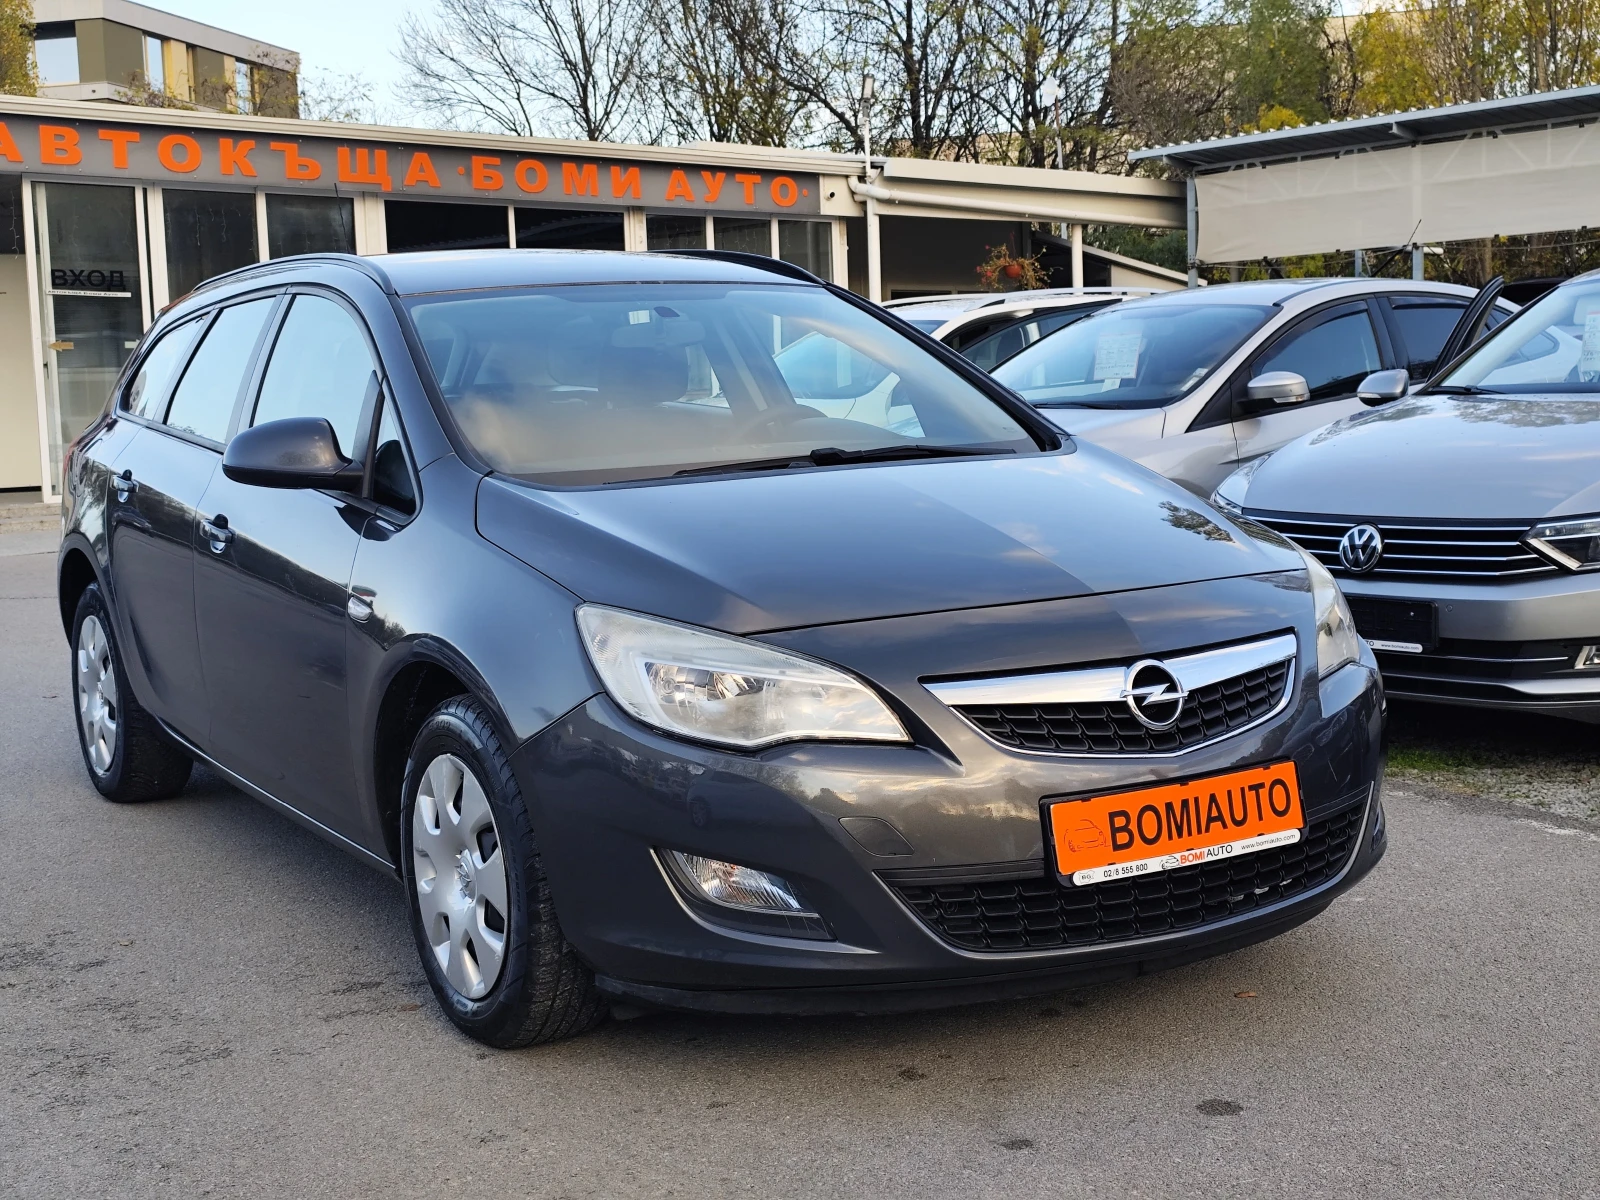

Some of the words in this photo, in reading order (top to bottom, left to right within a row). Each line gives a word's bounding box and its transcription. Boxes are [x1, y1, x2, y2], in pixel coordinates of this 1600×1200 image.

[470, 156, 643, 199] БОМИ
[665, 170, 799, 208] АУТО
[51, 269, 126, 291] ВХОД
[1108, 778, 1291, 852] BOMIAUTO
[1103, 868, 1120, 878] 02/8
[1121, 866, 1134, 875] 555
[1135, 863, 1148, 872] 800
[1180, 850, 1205, 865] BOMI
[1206, 844, 1233, 858] AUTO
[1241, 834, 1296, 850] www.bomiauto.com
